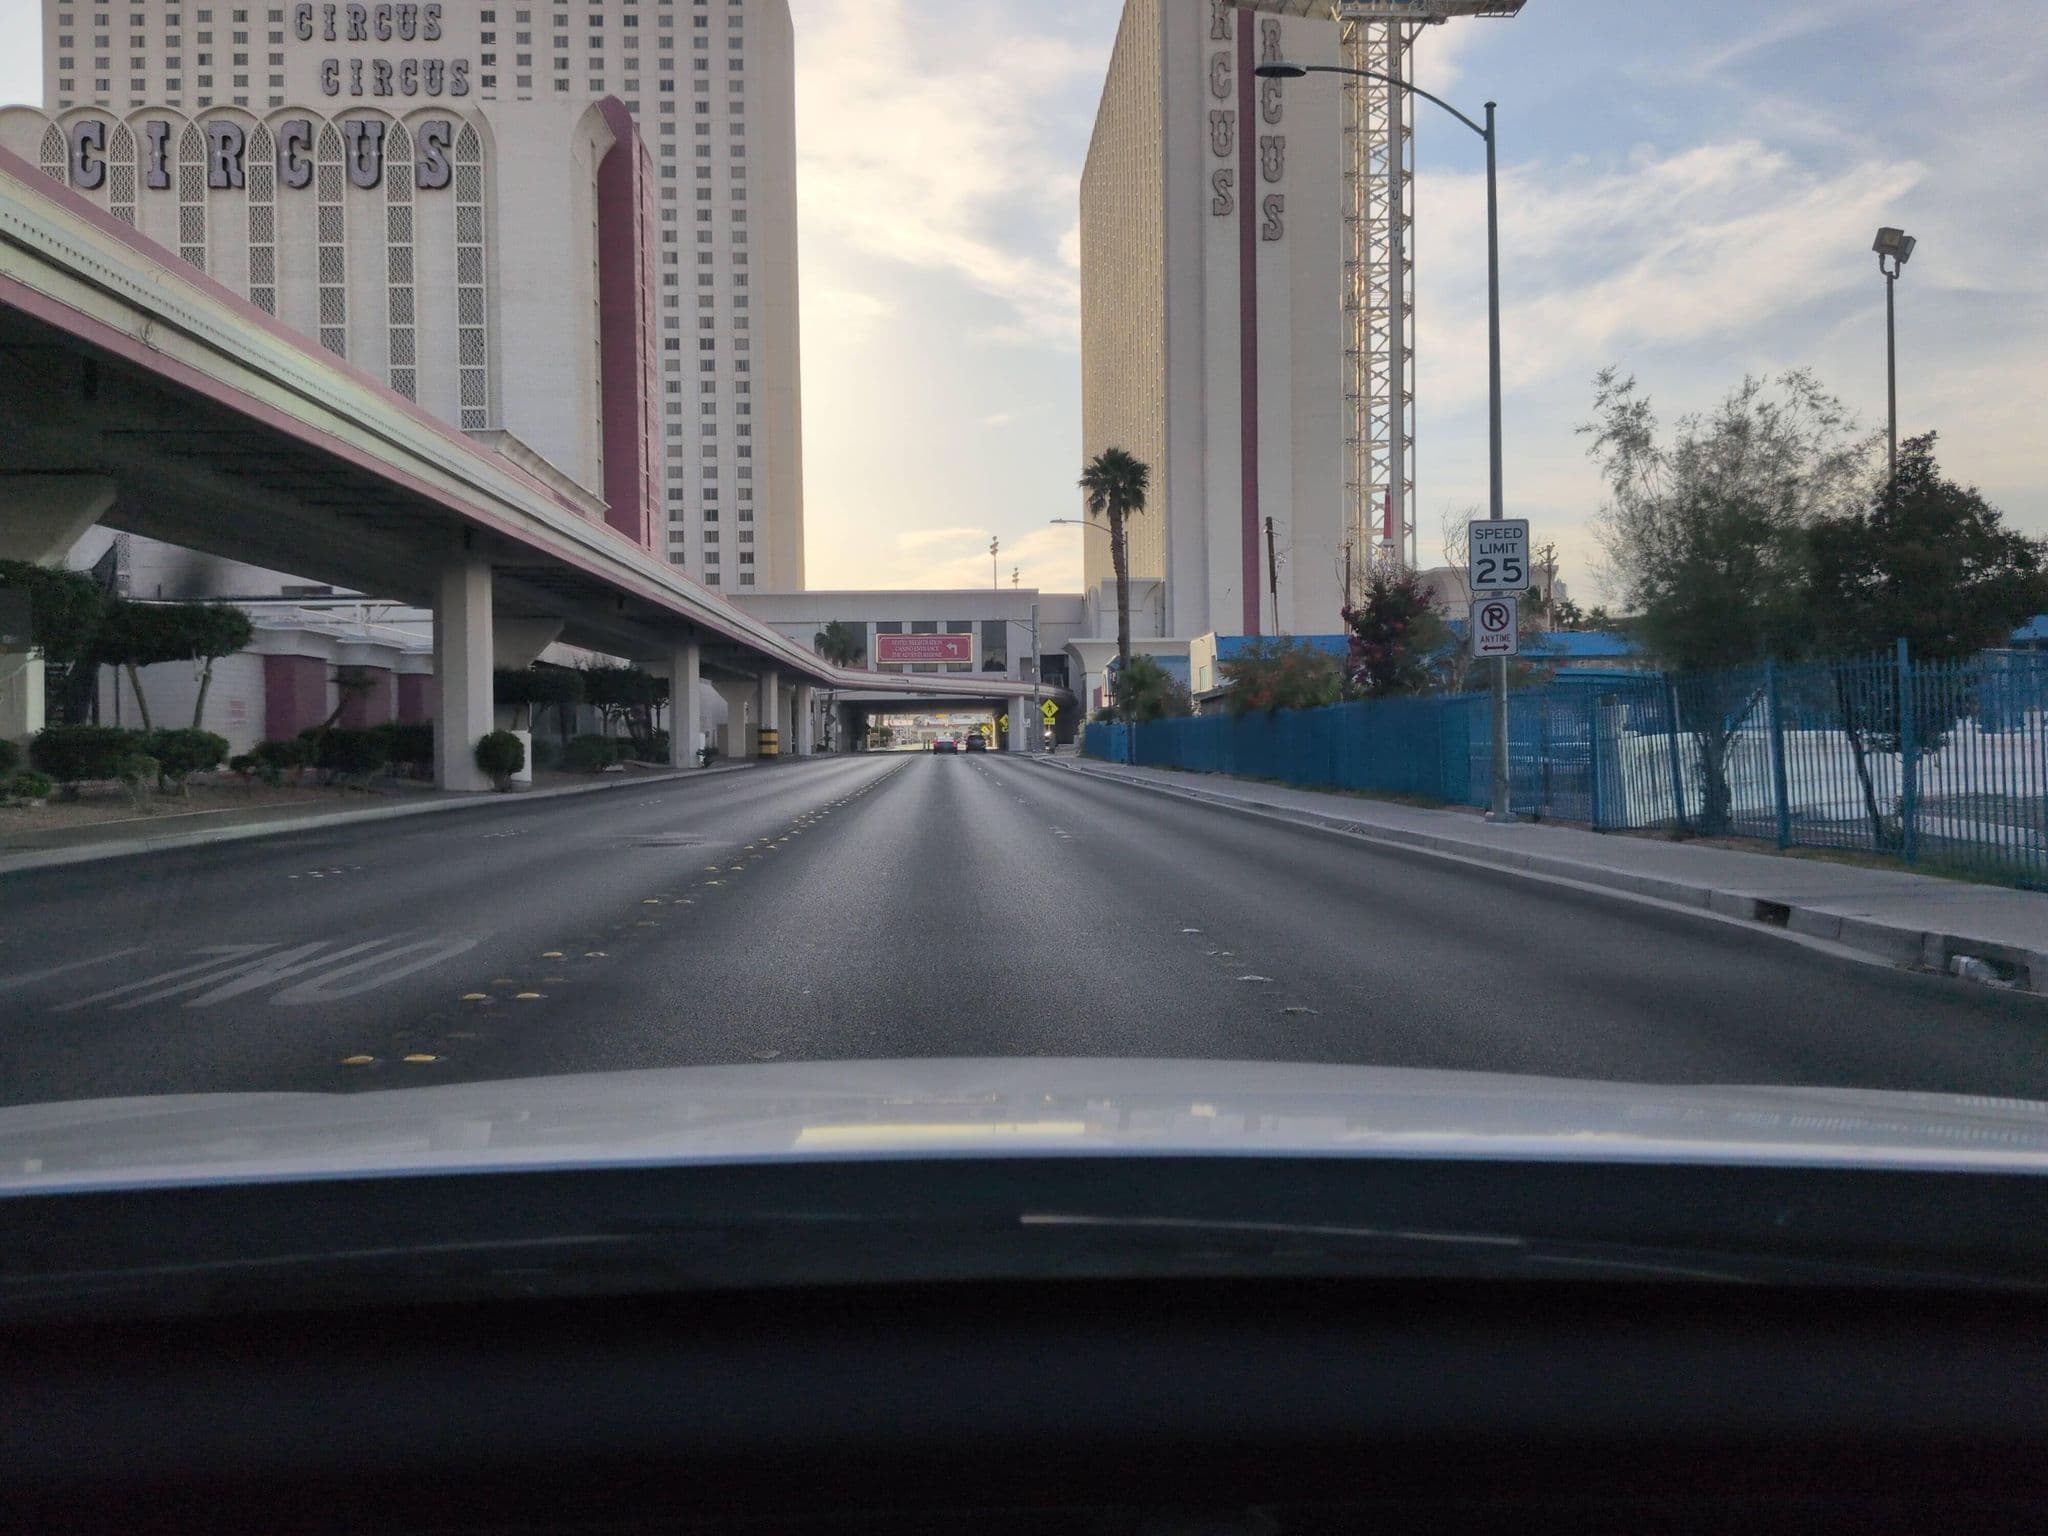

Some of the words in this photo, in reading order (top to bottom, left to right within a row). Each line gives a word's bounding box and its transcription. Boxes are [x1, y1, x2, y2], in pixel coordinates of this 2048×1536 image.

[295, 3, 442, 41] CIRCUS
[320, 58, 469, 96] CIRCUS
[72, 120, 451, 189] CIRCUS
[1475, 528, 1523, 540] SPEED
[1480, 543, 1518, 554] LIMIT
[1476, 558, 1522, 583] 25
[1480, 633, 1511, 643] ANYTIME
